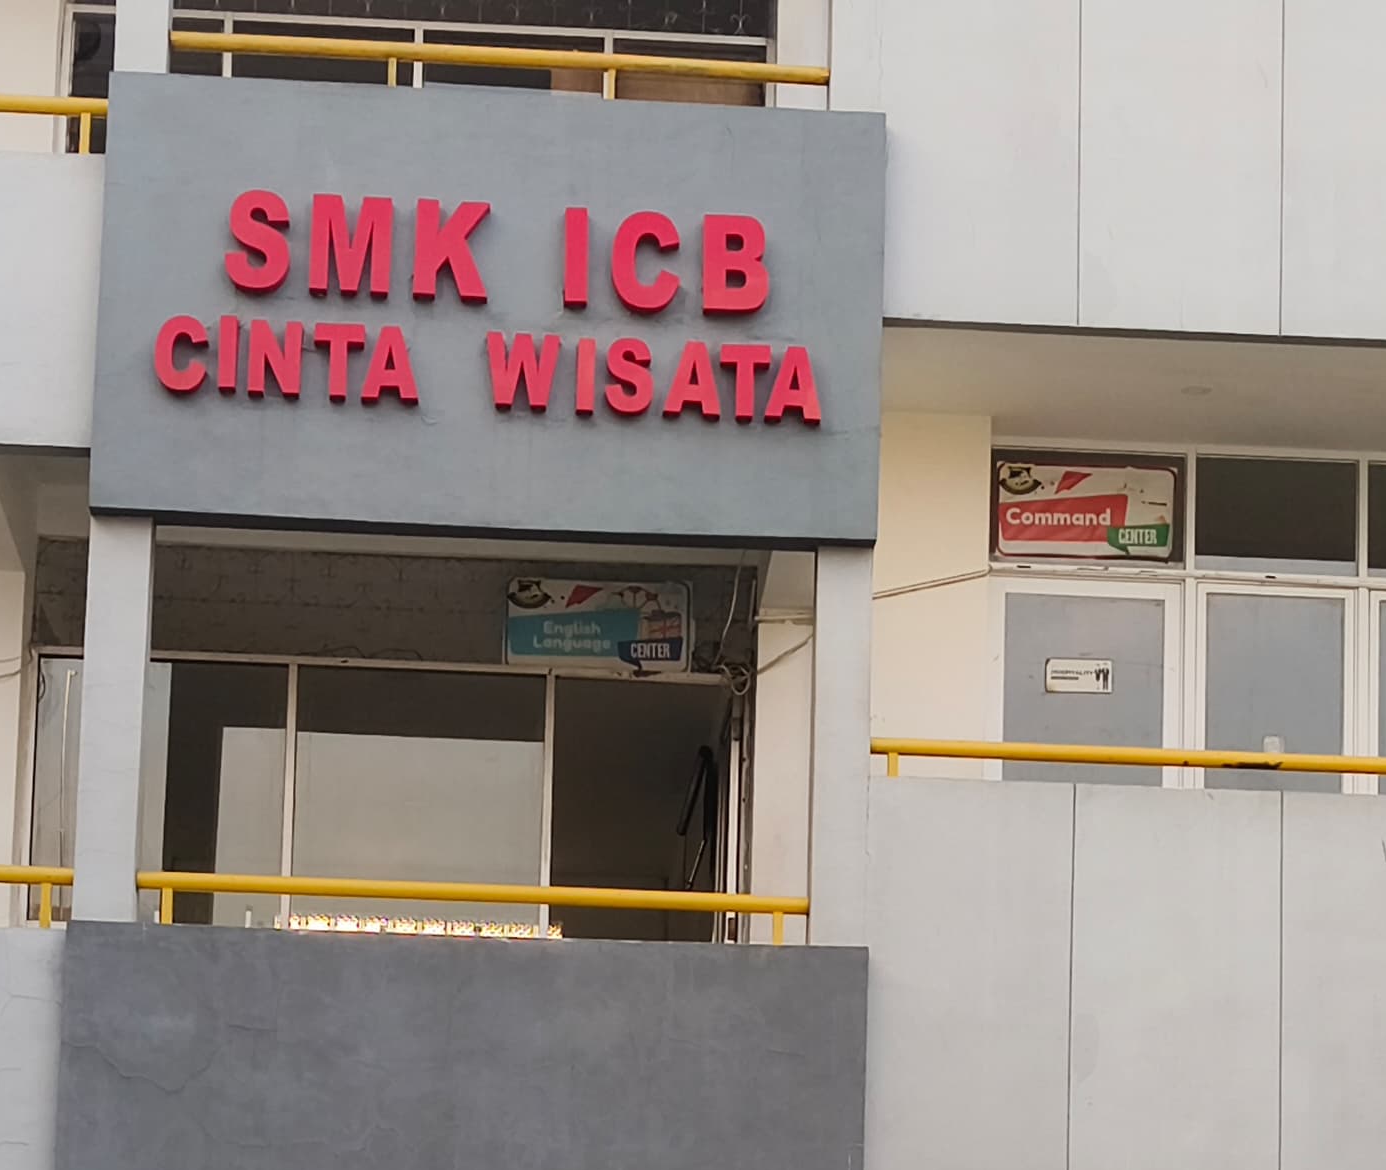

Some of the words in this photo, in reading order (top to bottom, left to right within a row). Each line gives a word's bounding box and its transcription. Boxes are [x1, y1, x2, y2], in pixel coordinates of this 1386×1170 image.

[223, 188, 491, 304] SMK
[562, 206, 770, 315] ICB
[153, 314, 419, 405] CINTA
[486, 330, 823, 426] WISATA
[1005, 508, 1112, 526] Command
[1118, 528, 1158, 545] CENTER
[543, 620, 601, 637] English
[533, 635, 611, 652] Language
[630, 642, 671, 659] CENTER
